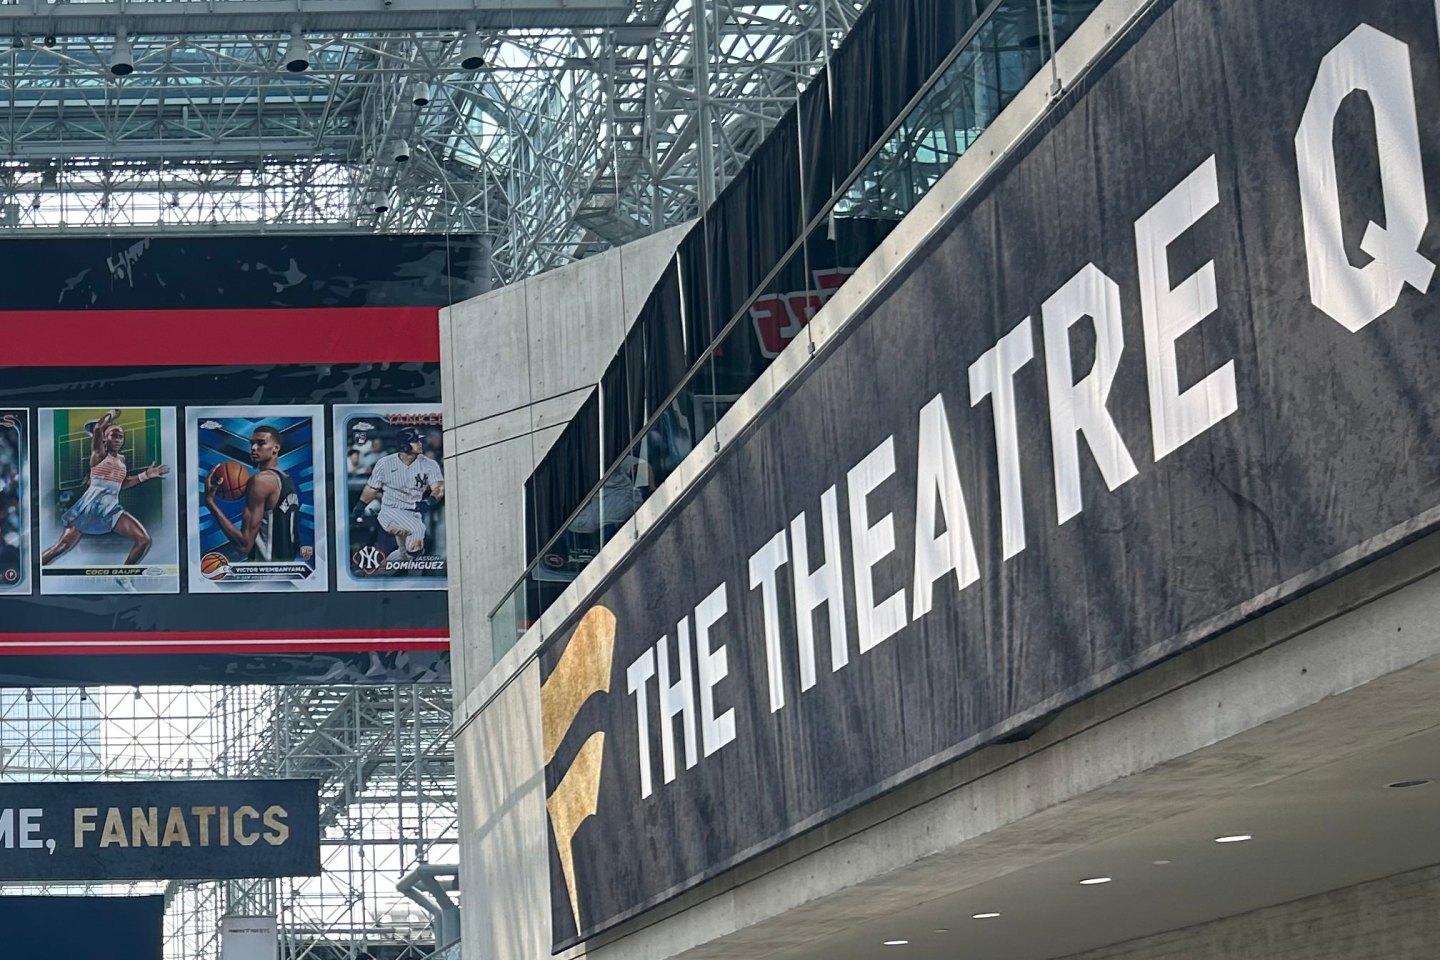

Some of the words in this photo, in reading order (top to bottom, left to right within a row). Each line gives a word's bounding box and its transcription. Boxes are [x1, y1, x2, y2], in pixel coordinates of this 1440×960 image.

[626, 580, 737, 801] THE
[747, 153, 1239, 714] THEATRE
[385, 560, 444, 570] DOMÍNGUEZ
[73, 804, 290, 848] FANATICS
